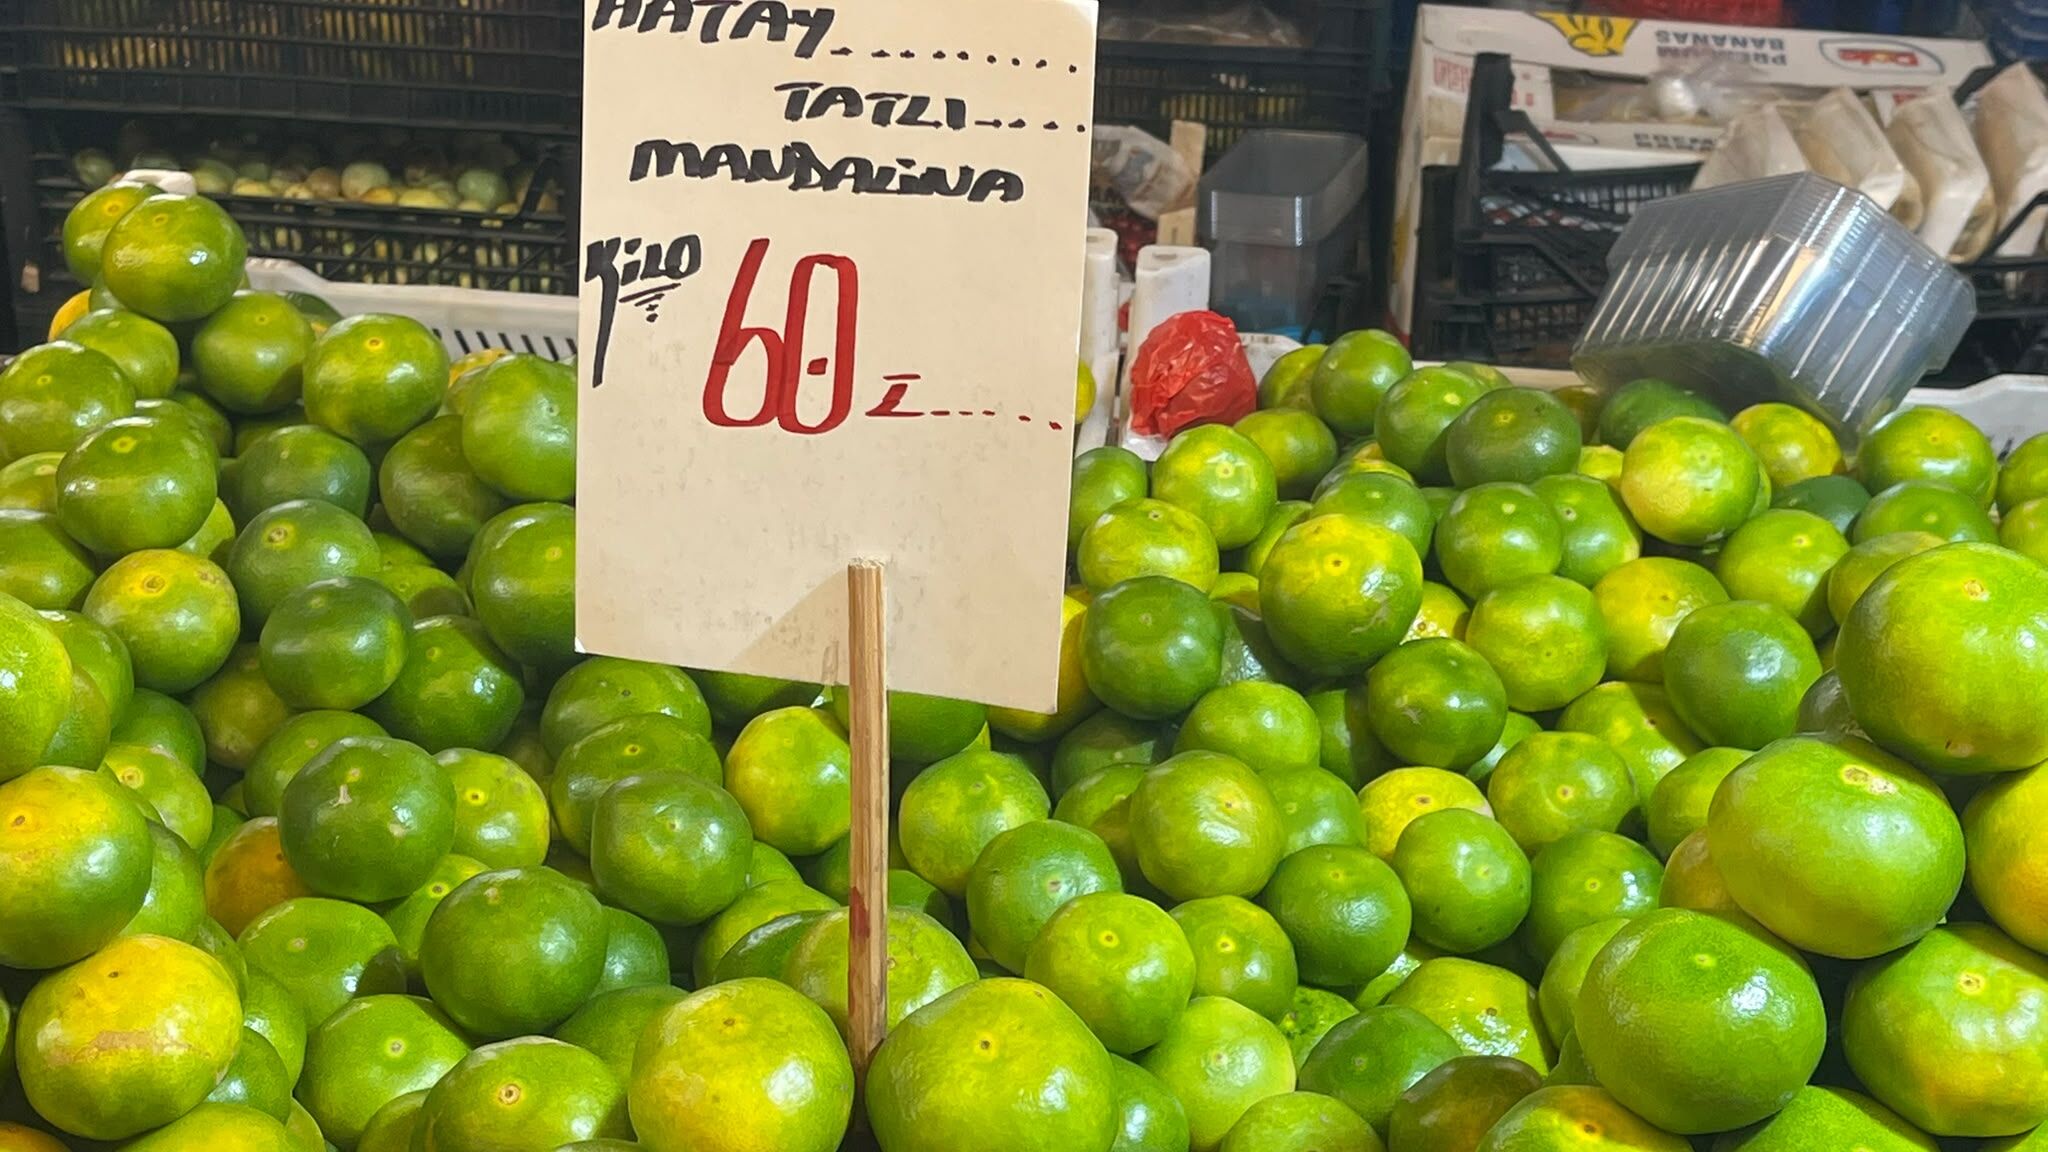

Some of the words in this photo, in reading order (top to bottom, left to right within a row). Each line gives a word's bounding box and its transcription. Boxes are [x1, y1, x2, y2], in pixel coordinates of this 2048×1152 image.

[592, 0, 834, 58] HATAY
[1654, 31, 1785, 51] BANANAS
[775, 83, 966, 130] TATLI
[703, 239, 858, 433] 60
